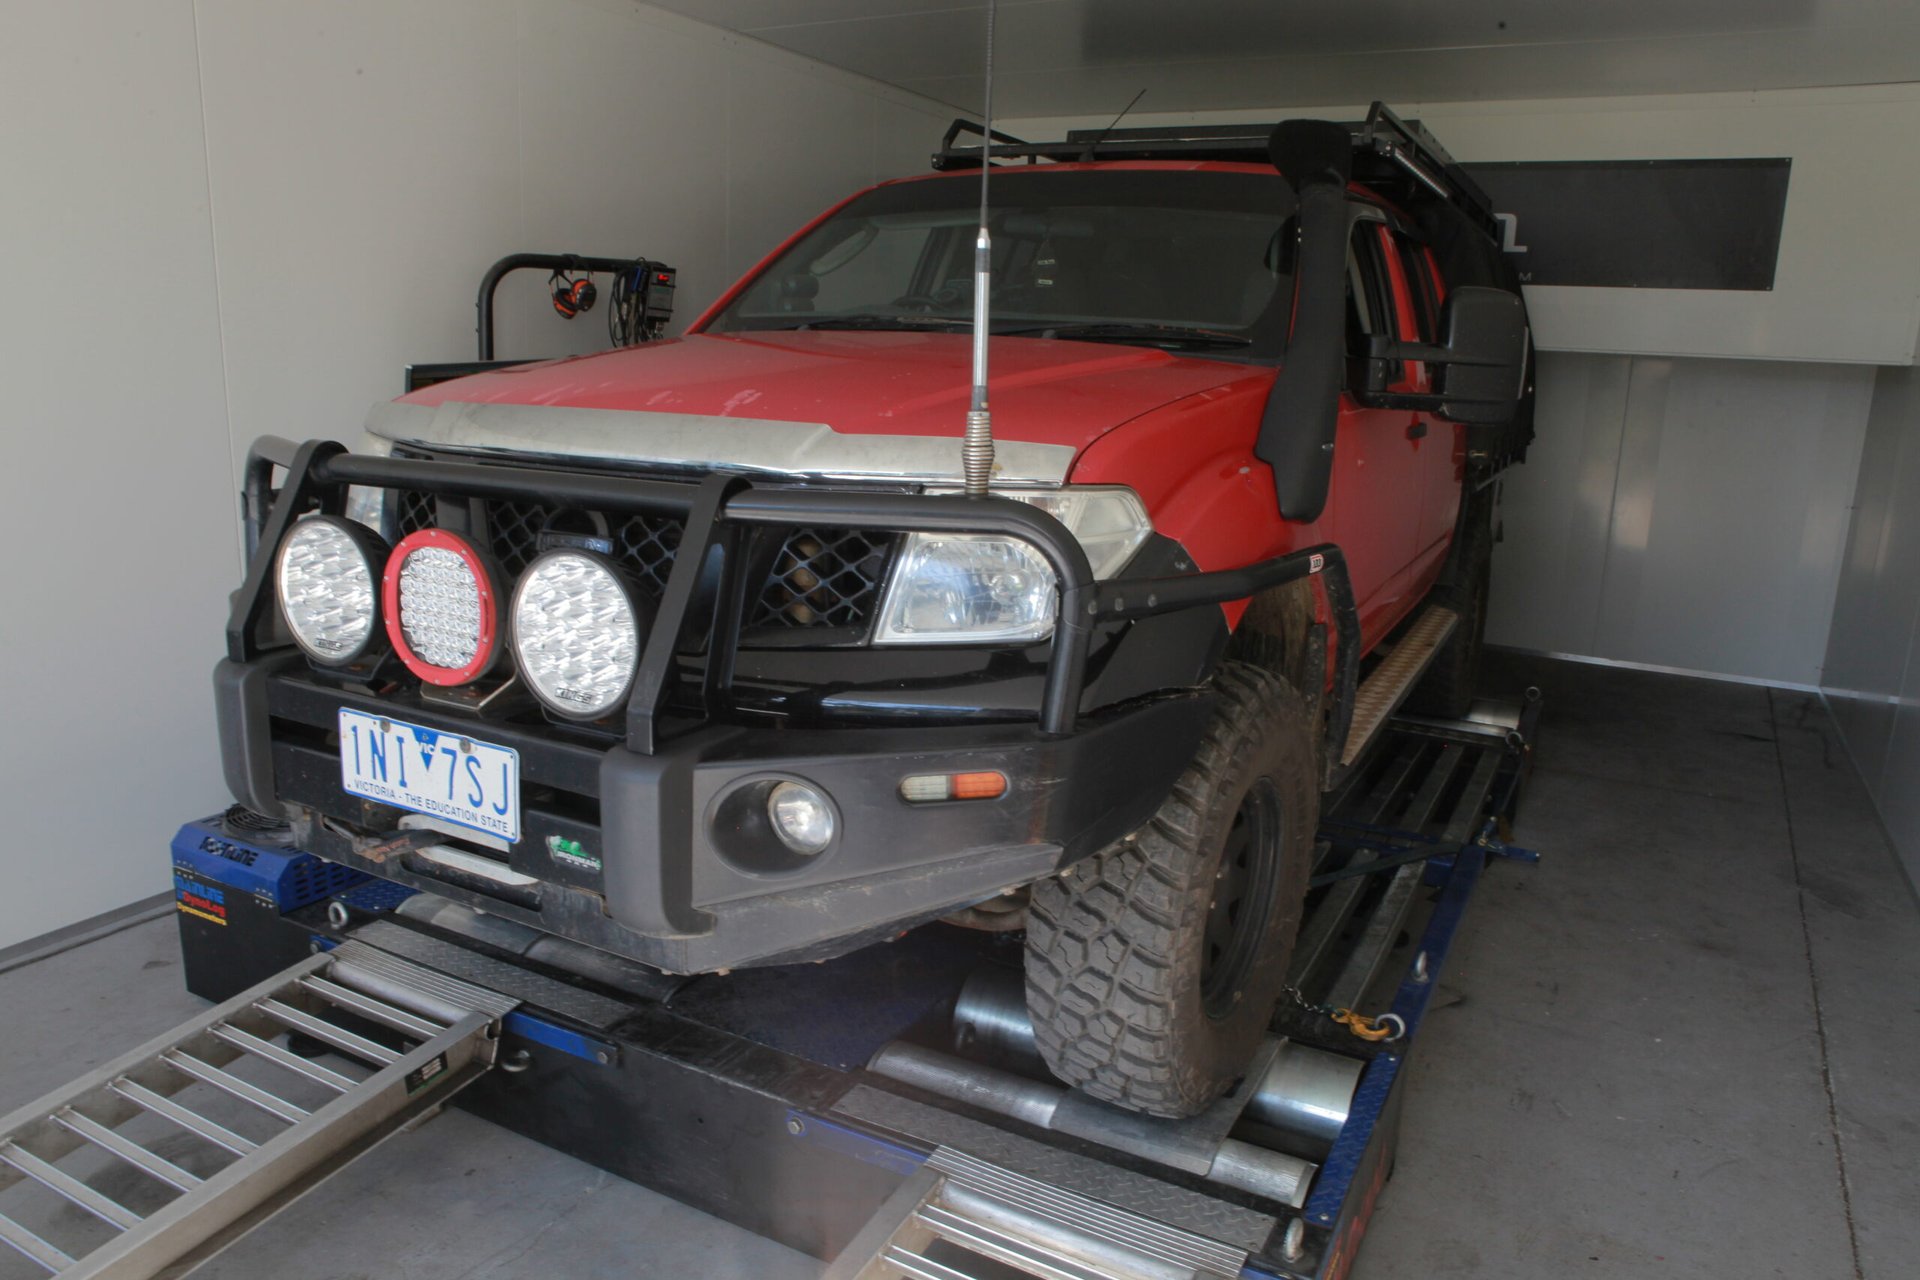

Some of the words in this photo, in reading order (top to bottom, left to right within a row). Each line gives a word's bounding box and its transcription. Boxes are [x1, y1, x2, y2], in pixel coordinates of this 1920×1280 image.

[555, 687, 592, 704] KINGS
[351, 725, 408, 788] 1NI
[441, 746, 508, 816] 7SJ
[354, 779, 396, 800] VICTORIA
[405, 793, 422, 809] THE
[425, 798, 478, 823] EDUCATION
[480, 814, 508, 833] STATE
